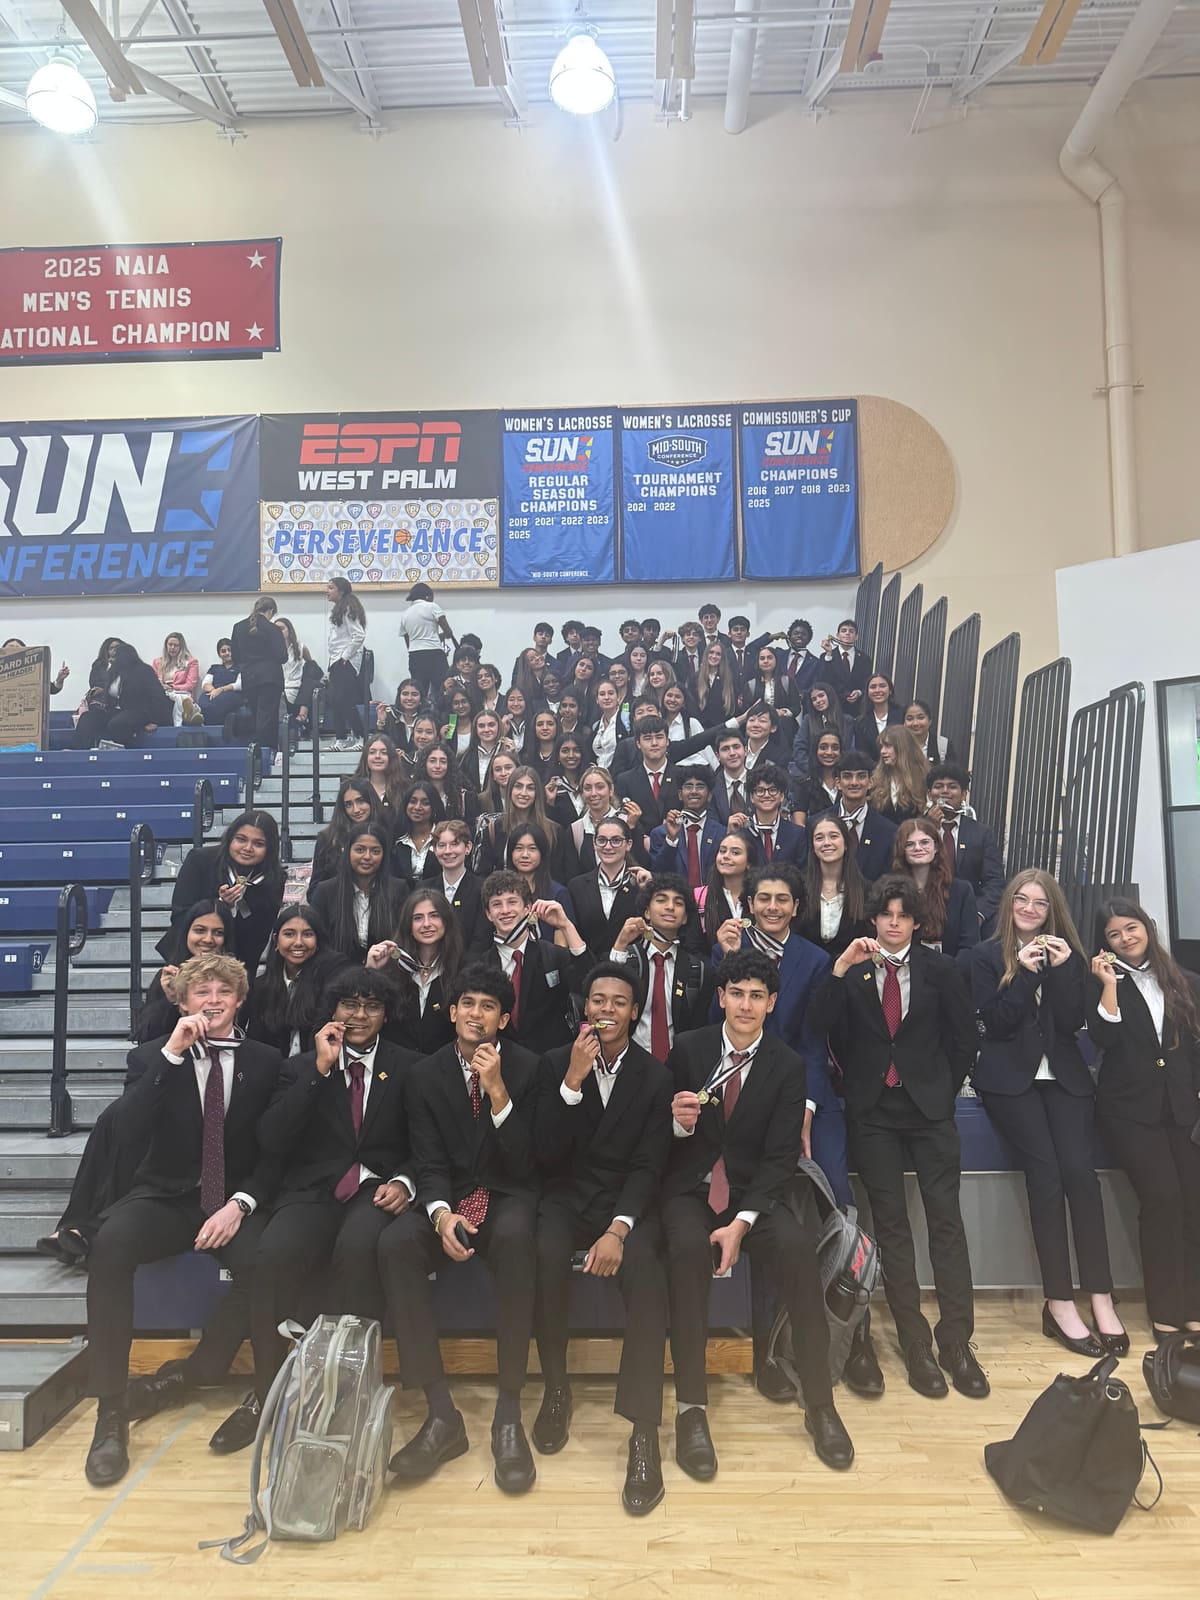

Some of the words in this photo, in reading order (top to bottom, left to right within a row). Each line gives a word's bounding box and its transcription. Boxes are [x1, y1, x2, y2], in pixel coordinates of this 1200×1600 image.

[44, 256, 102, 278] 2025
[115, 254, 170, 276] NAIA
[23, 290, 91, 313] MEN'S
[106, 287, 192, 310] TENNIS
[112, 320, 231, 345] CHAMPION
[504, 416, 554, 432] WOMEN'S
[558, 415, 613, 431] LACROSSE
[622, 414, 672, 429] WOMEN'S
[677, 413, 732, 428] LACROSSE
[743, 409, 828, 425] COMMISSIONER'S
[831, 408, 852, 422] CUP
[300, 421, 462, 465] ESPN
[524, 436, 579, 463] SUN
[652, 439, 702, 456] MID-SOUTH
[764, 430, 821, 456] SUN
[298, 470, 374, 491] WEST
[381, 469, 457, 490] PALM
[528, 475, 589, 488] REGULAR
[633, 472, 723, 486] TOURNAMENT
[760, 468, 838, 482] CHAMPIONS
[533, 488, 585, 500] SEASON
[640, 484, 717, 498] CHAMPIONS
[747, 486, 768, 496] 2016
[774, 485, 795, 495] 2017
[801, 484, 821, 494] 2018
[828, 484, 850, 493] 2023
[520, 500, 597, 513] CHAMPIONS
[627, 502, 647, 512] 2021
[653, 502, 676, 511] 2022
[748, 498, 771, 508] 2025
[586, 515, 609, 525] 2023
[508, 530, 531, 540] 2025
[24, 653, 39, 665] KIT
